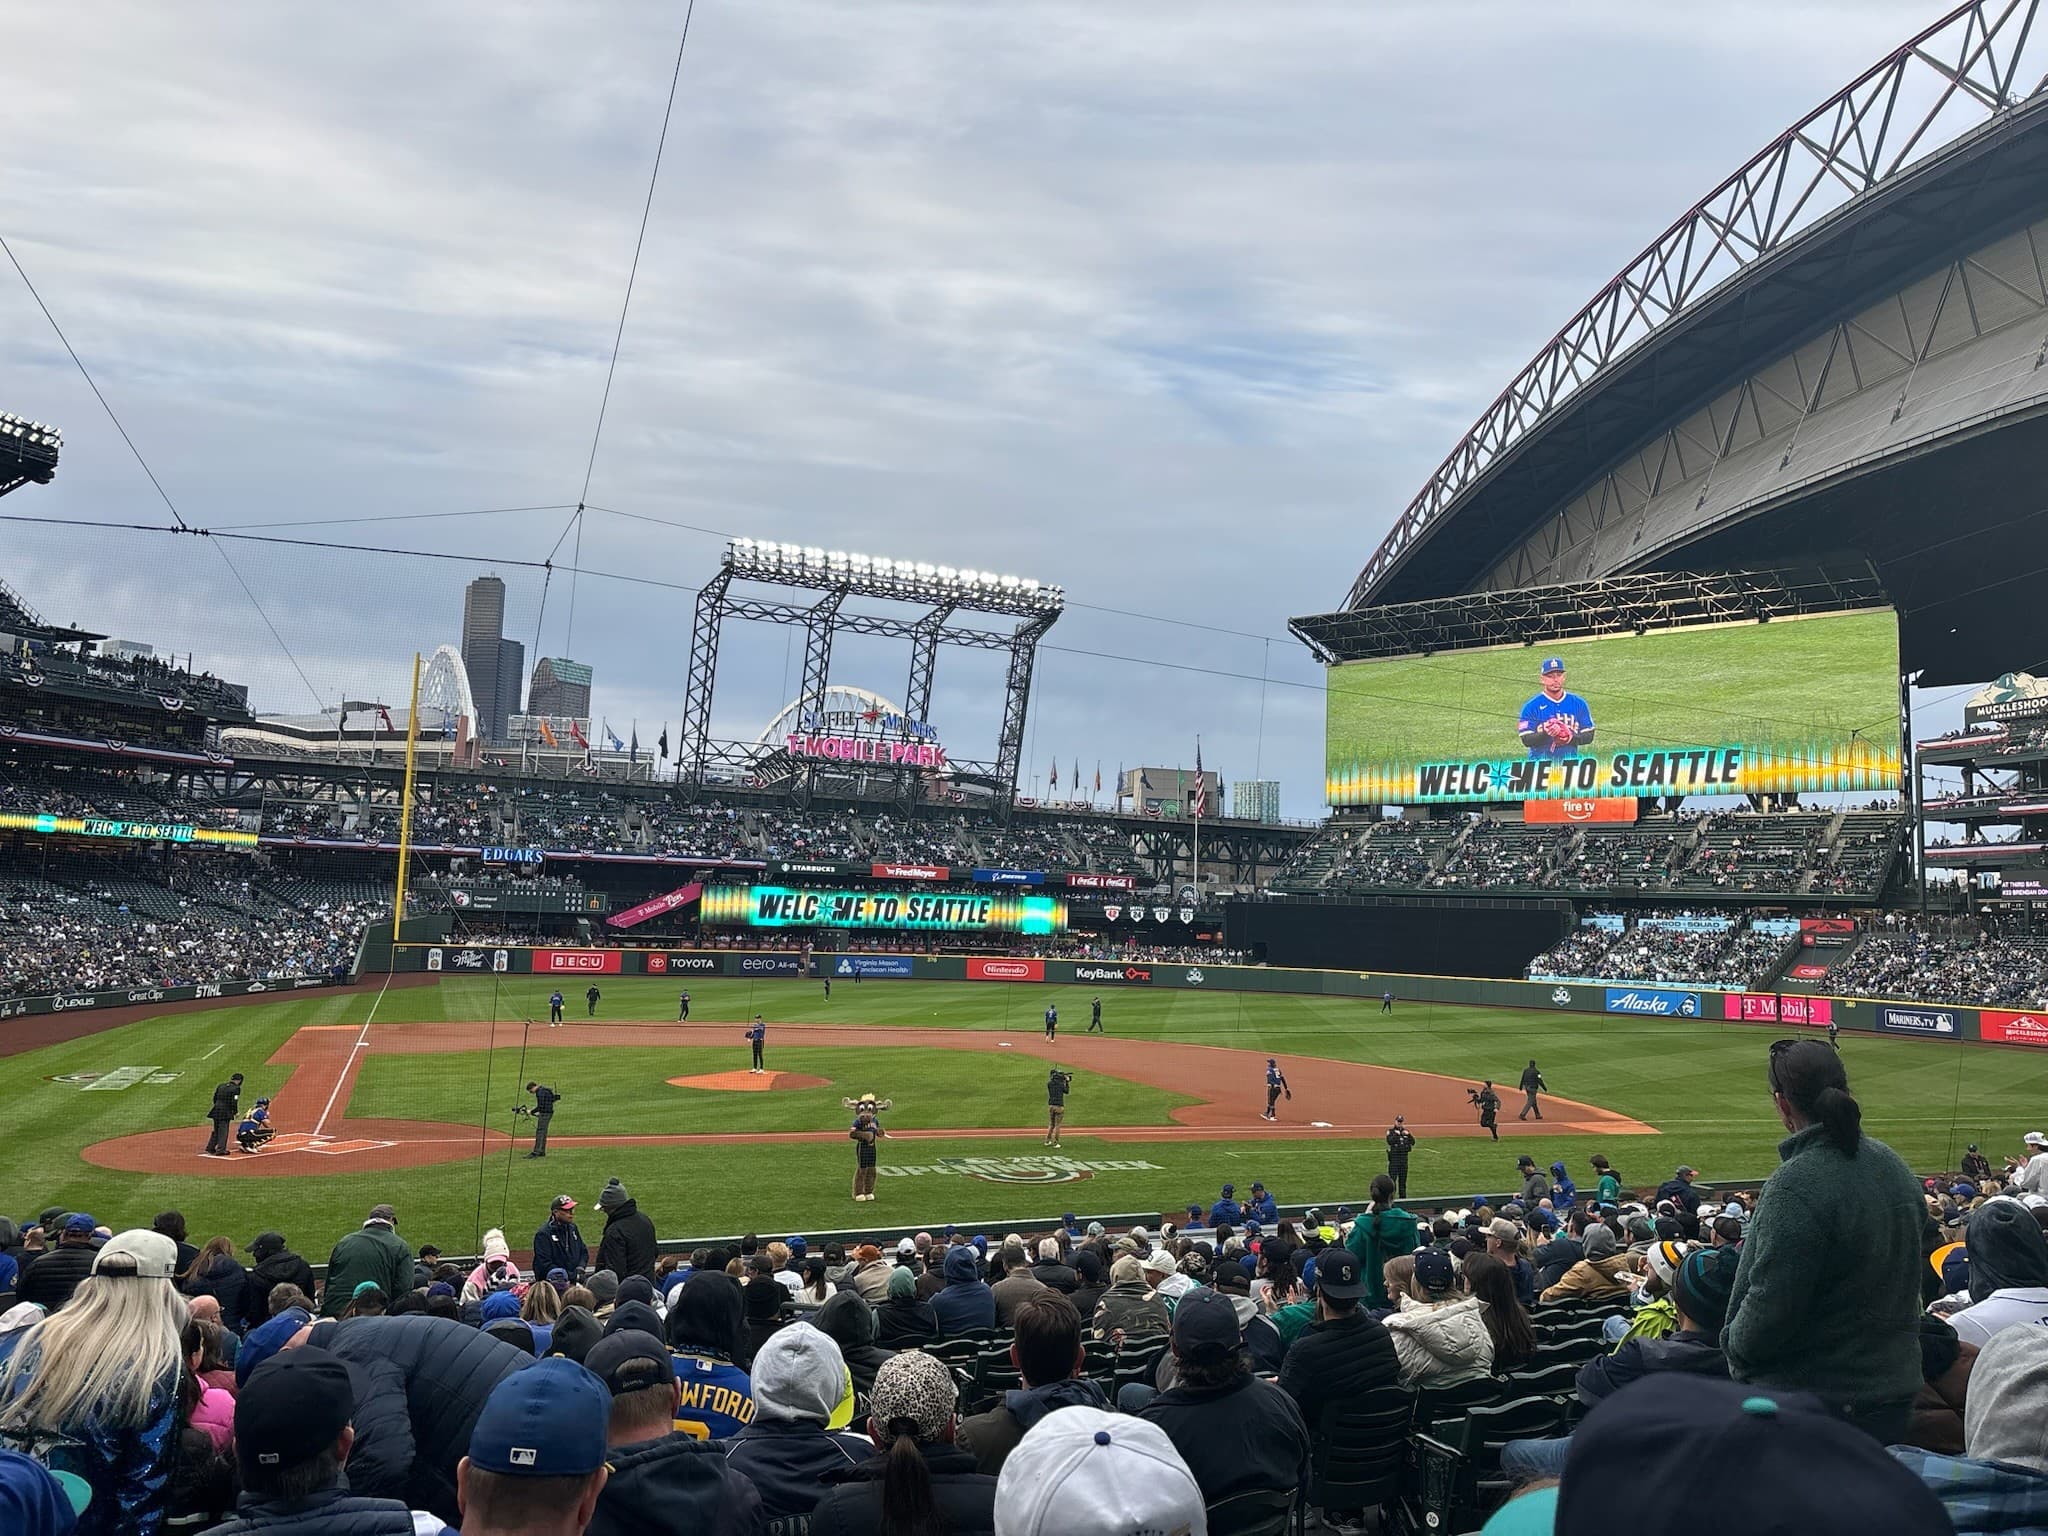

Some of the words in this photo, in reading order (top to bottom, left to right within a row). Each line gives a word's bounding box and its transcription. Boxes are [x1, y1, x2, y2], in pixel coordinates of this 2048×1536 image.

[803, 711, 856, 729] SEATTLE
[882, 713, 938, 739] MARINERS
[786, 734, 887, 763] T-MOBILE
[891, 742, 948, 768] PARK
[1419, 760, 1553, 796] WELCME
[1562, 758, 1597, 791] TO
[1611, 750, 1741, 786] SEATTLE
[1563, 802, 1581, 812] fire
[1583, 803, 1595, 812] tv
[83, 820, 138, 838] WELCME
[140, 823, 153, 838] TO
[155, 824, 197, 840] SEATTLE
[482, 848, 545, 864] EDGARS
[792, 864, 836, 873] STARBUCKS
[757, 893, 866, 922] WELCME
[873, 897, 899, 922] TO
[906, 897, 988, 924] SEATTLE
[554, 956, 601, 967] BECU
[671, 959, 715, 969] TOYOTA
[742, 958, 776, 970] eero
[854, 959, 878, 967] Virginia
[986, 965, 1026, 975] Nintendo
[1076, 967, 1125, 981] KeyBank
[128, 990, 147, 1001] Great
[148, 989, 164, 1002] Clips
[194, 984, 222, 998] STIHL
[1555, 990, 1568, 999] 50
[64, 997, 96, 1007] LEXUS
[1611, 992, 1669, 1013] Alaska
[1760, 999, 1815, 1018] Mobile
[1887, 1012, 1934, 1027] MARINERS.TV
[2005, 1028, 2048, 1038] MUCKLESHOO
[876, 1161, 1052, 1177] OPENING
[1050, 1160, 1167, 1173] WEEK
[680, 1381, 755, 1424] WFORD
